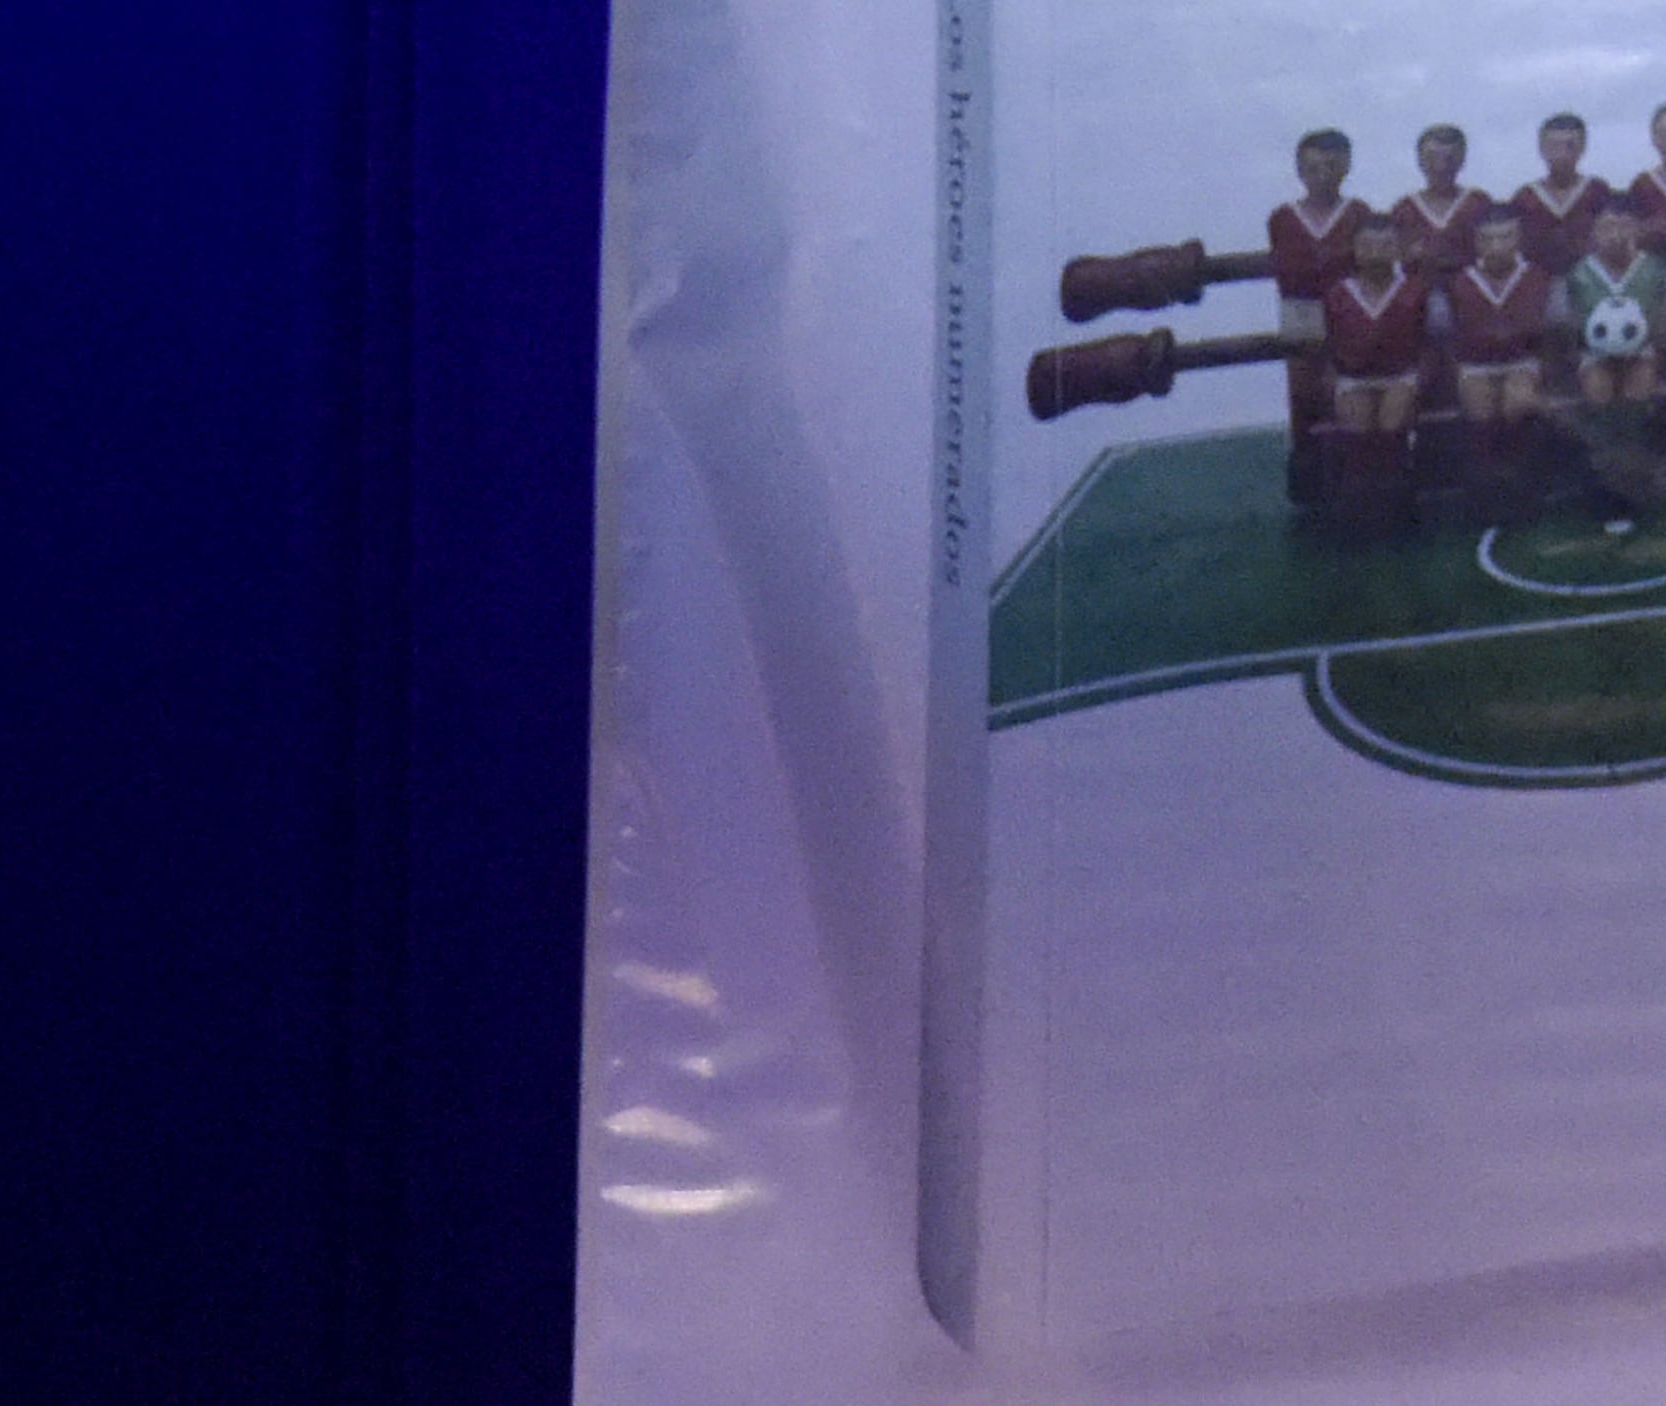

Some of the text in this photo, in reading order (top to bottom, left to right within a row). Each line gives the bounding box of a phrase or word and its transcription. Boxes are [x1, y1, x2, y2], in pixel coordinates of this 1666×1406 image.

[944, 0, 971, 588] os héroes numerados
